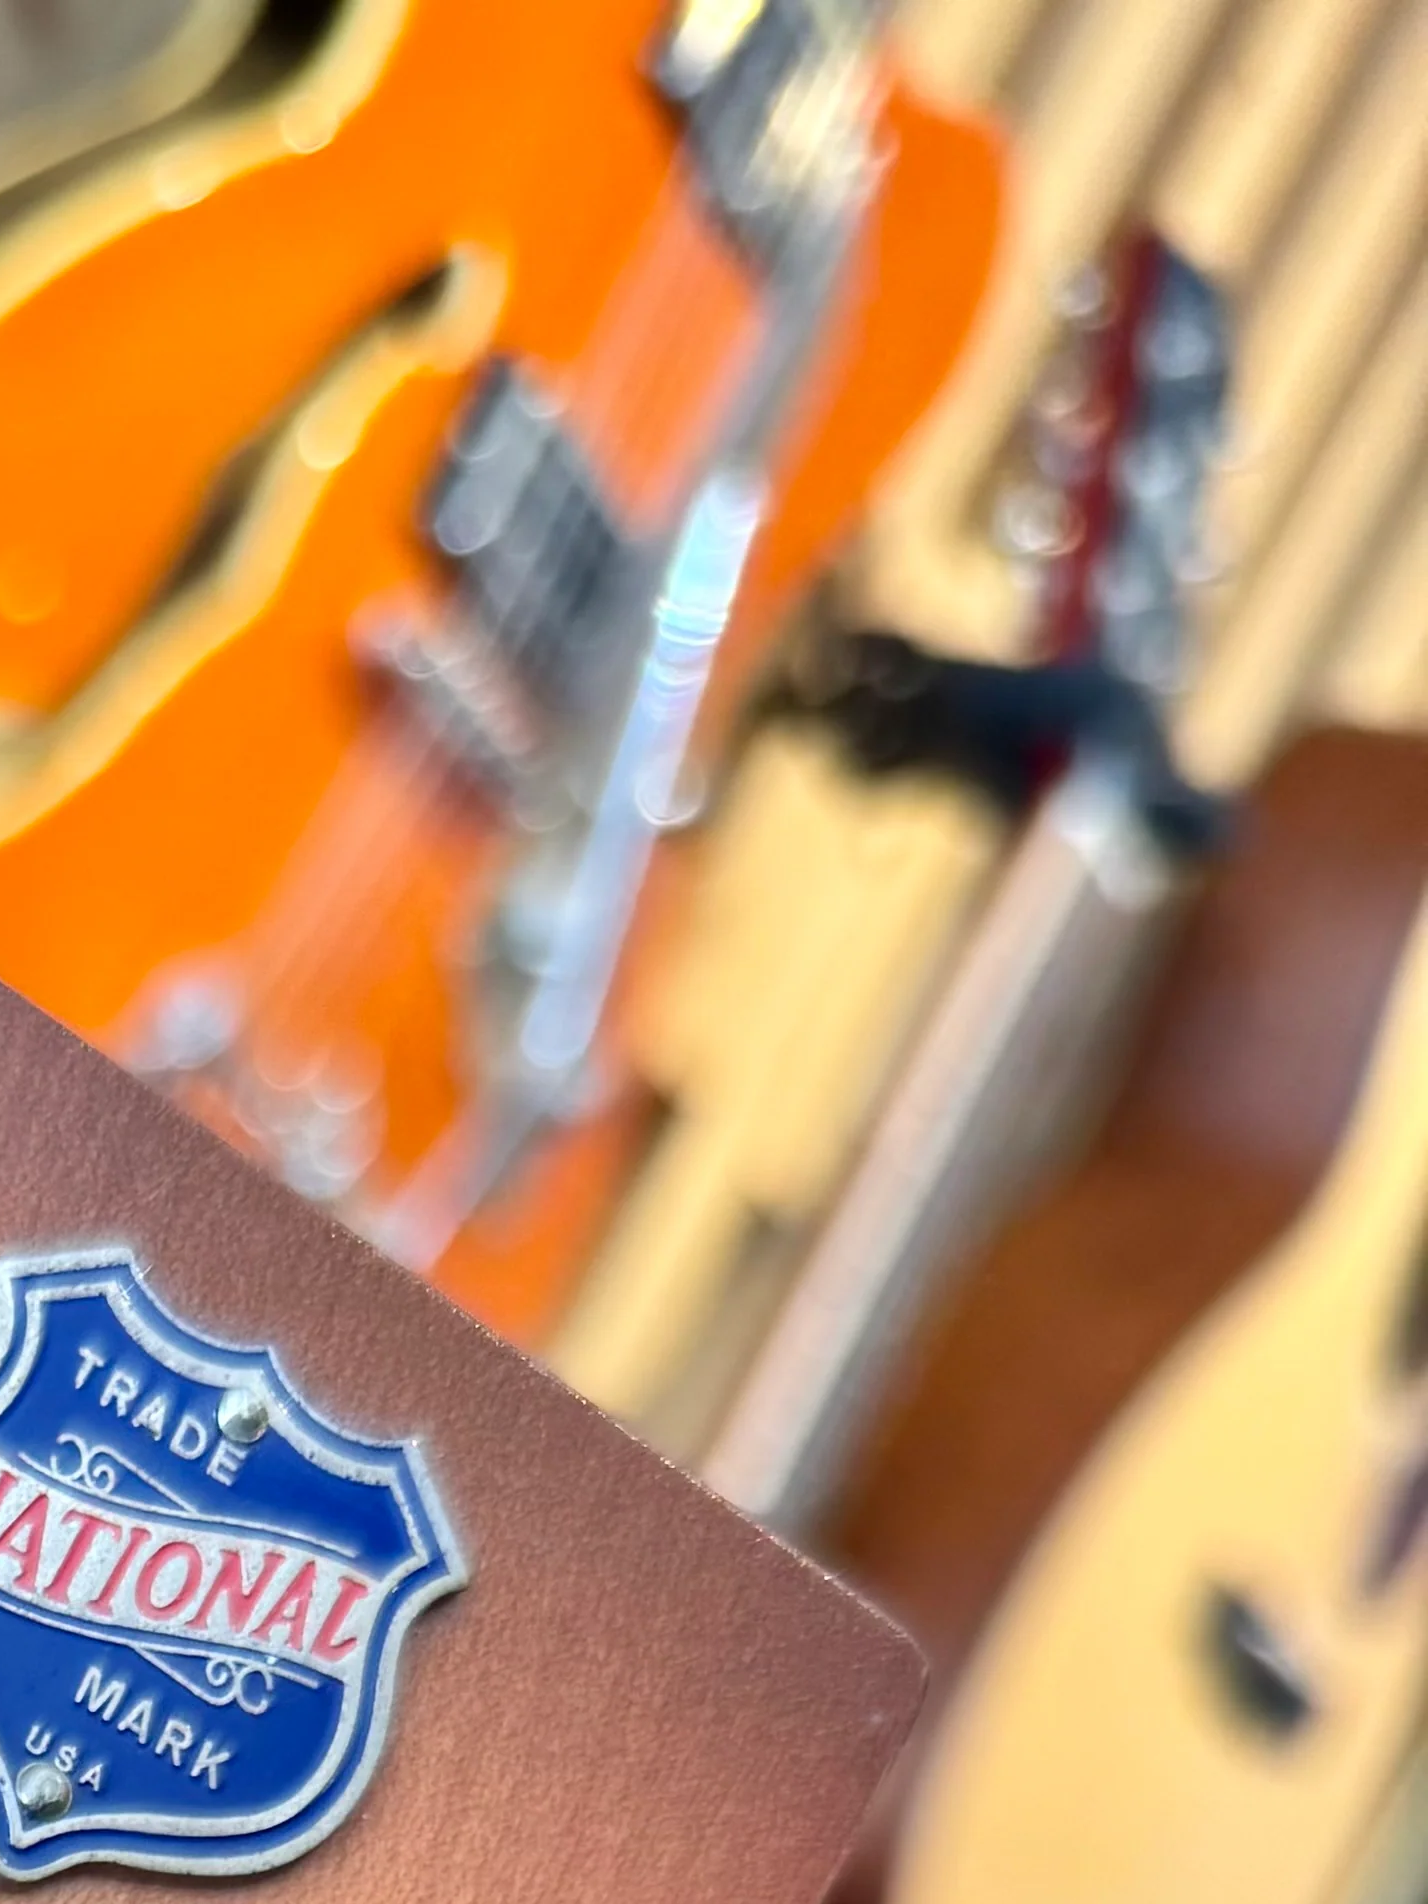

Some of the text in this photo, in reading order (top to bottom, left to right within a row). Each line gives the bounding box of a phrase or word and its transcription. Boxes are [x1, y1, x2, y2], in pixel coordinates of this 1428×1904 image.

[74, 1347, 249, 1487] TRADE
[25, 1725, 105, 1791] USA
[74, 1666, 232, 1790] MARK
